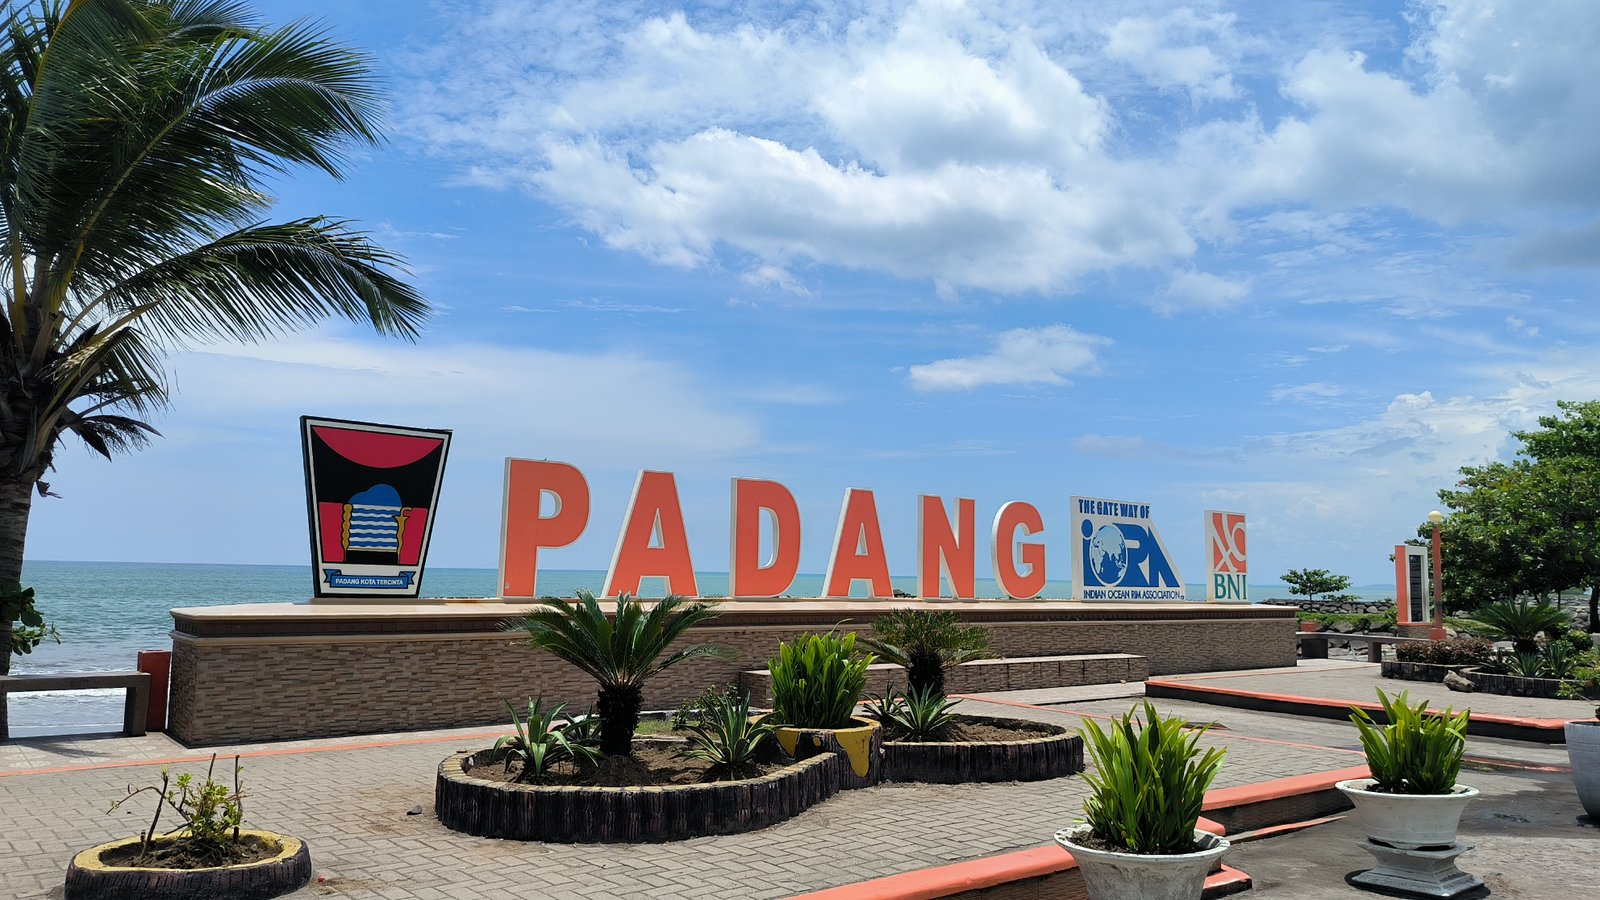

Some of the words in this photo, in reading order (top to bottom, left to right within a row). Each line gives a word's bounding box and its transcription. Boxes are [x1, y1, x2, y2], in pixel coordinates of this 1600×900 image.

[1078, 499, 1095, 515] THE
[1097, 500, 1118, 517] GATE
[1120, 503, 1138, 518] WAY
[1140, 505, 1150, 519] OF
[498, 457, 1047, 599] PADANG
[1083, 590, 1106, 599] INDIAN
[1107, 590, 1130, 599] OCEAN
[1131, 590, 1141, 599] RIM
[1142, 590, 1180, 600] ASSOCIATION
[1214, 573, 1247, 600] BNI
